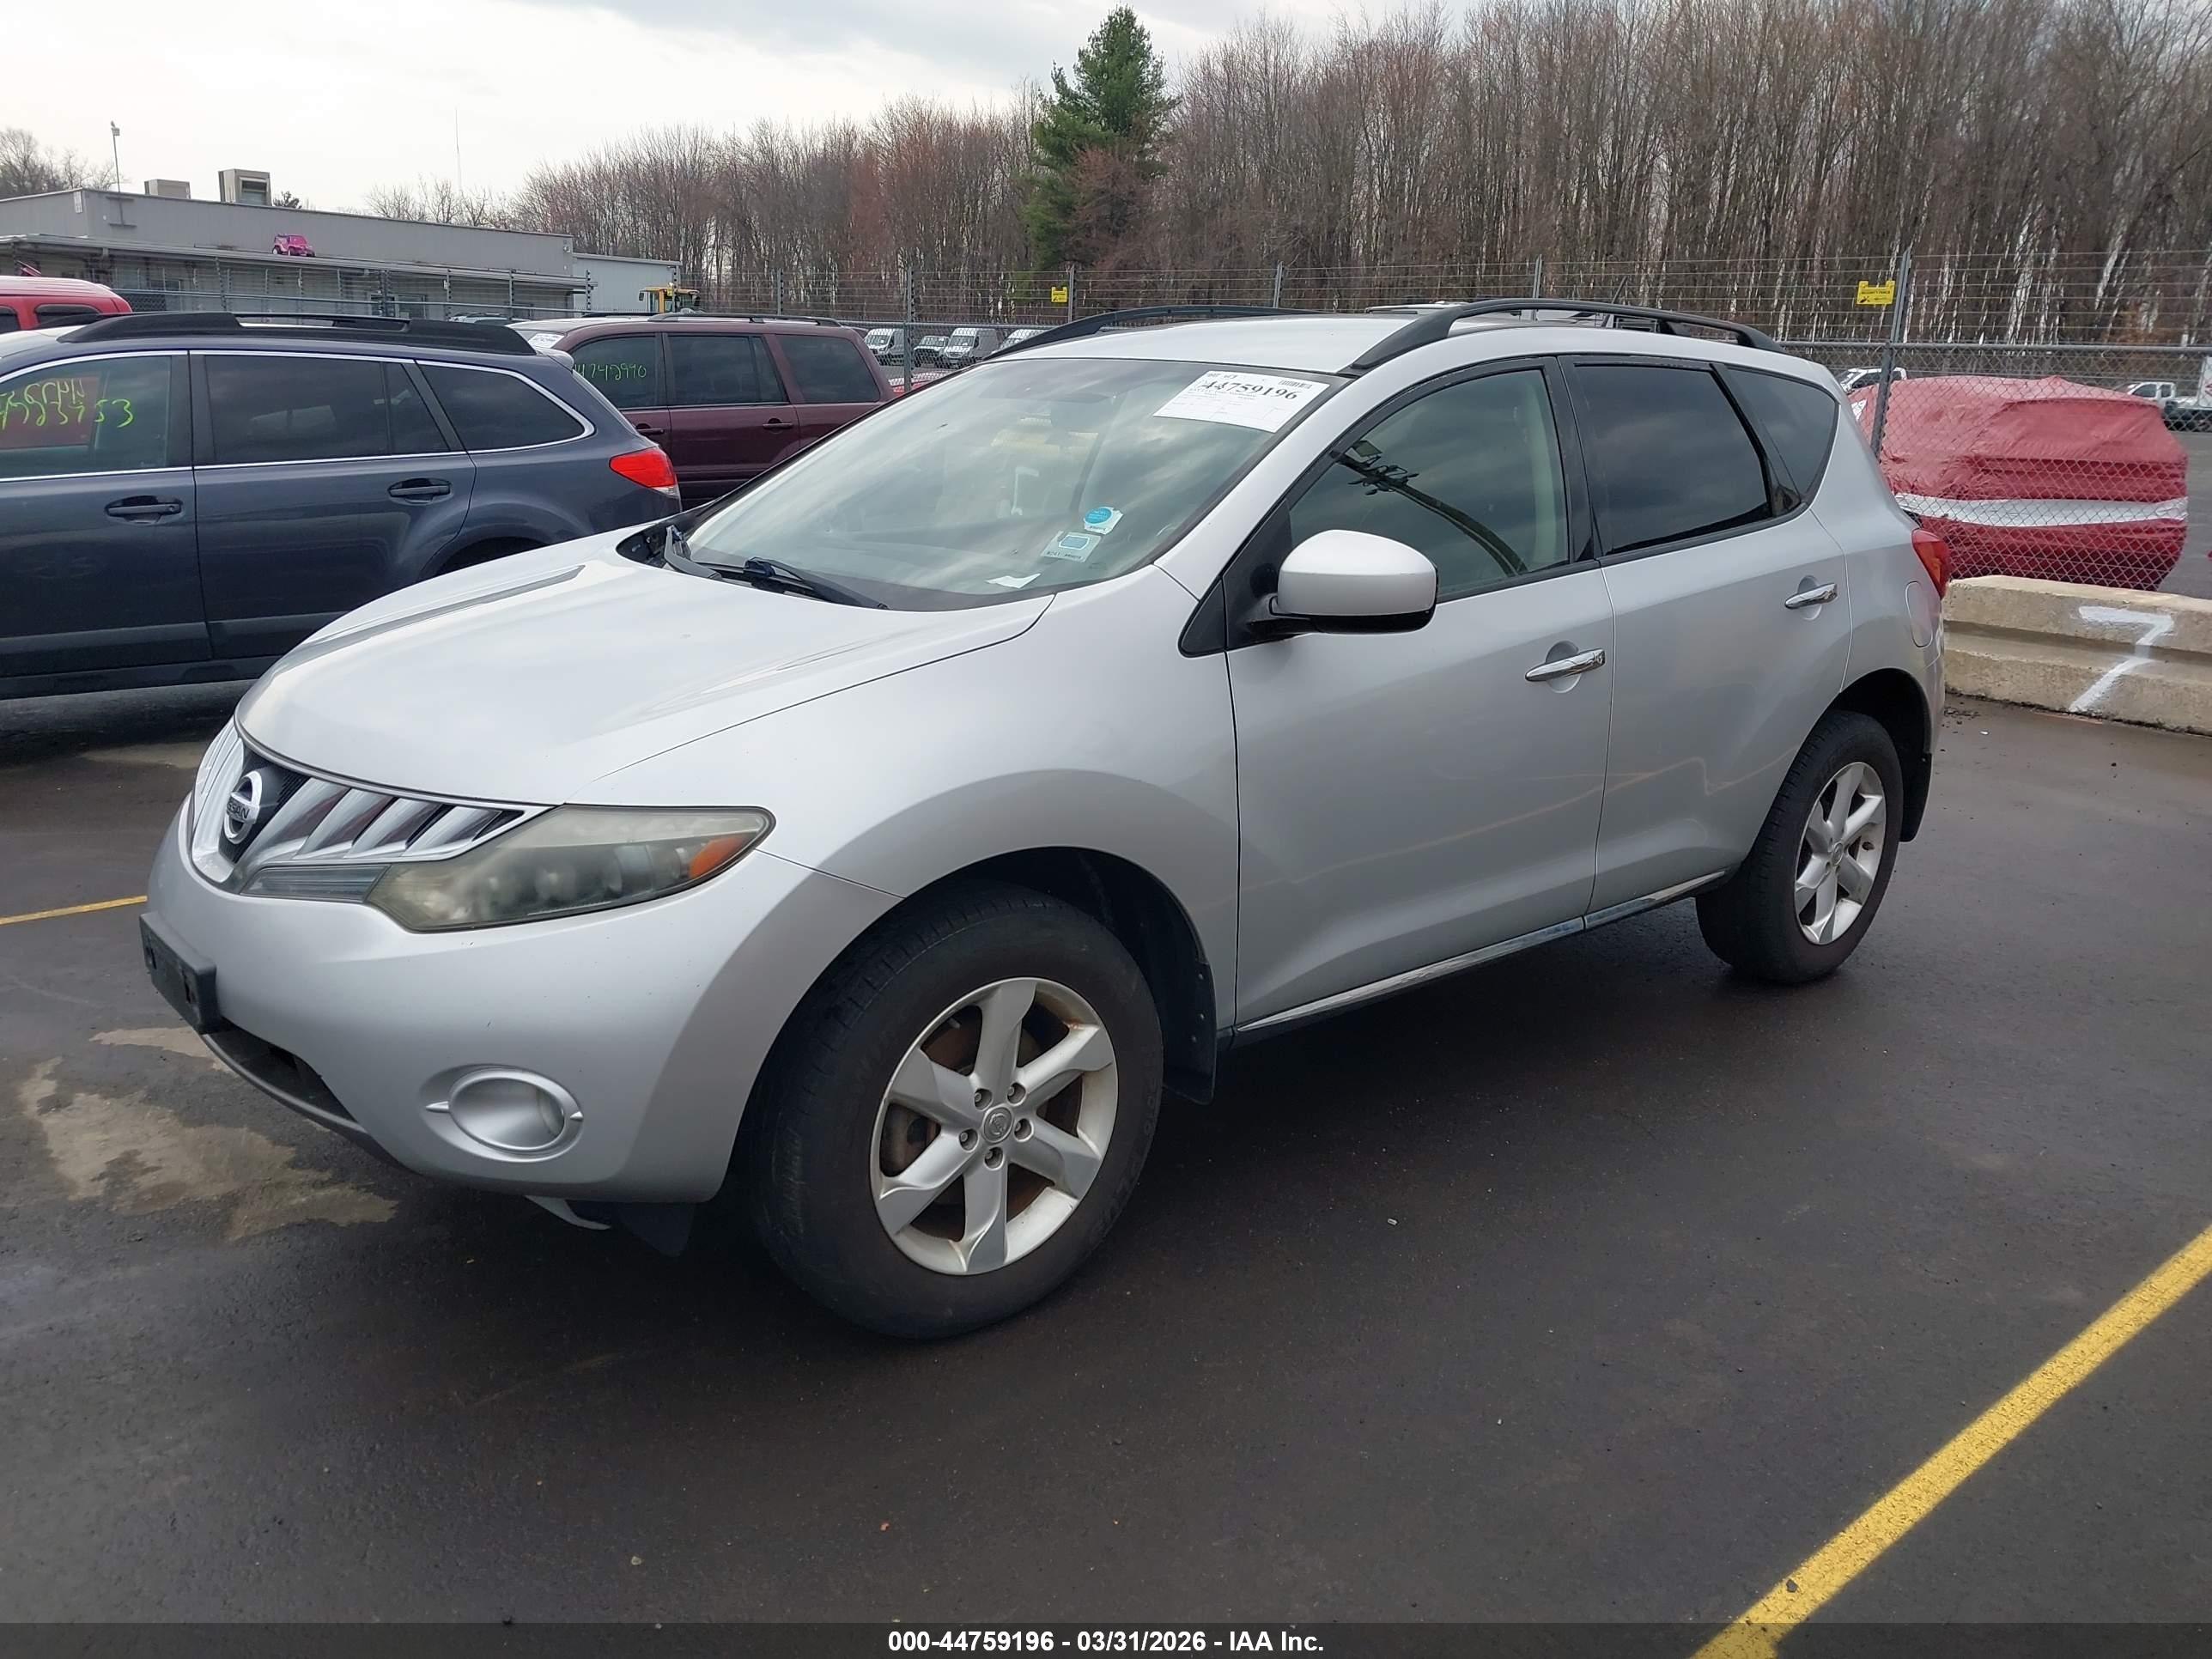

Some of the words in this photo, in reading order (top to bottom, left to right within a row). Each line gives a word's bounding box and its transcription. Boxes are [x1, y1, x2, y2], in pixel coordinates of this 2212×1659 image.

[1200, 380, 1303, 400] 44759196
[2070, 605, 2174, 713] 7
[227, 800, 250, 818] SSAN
